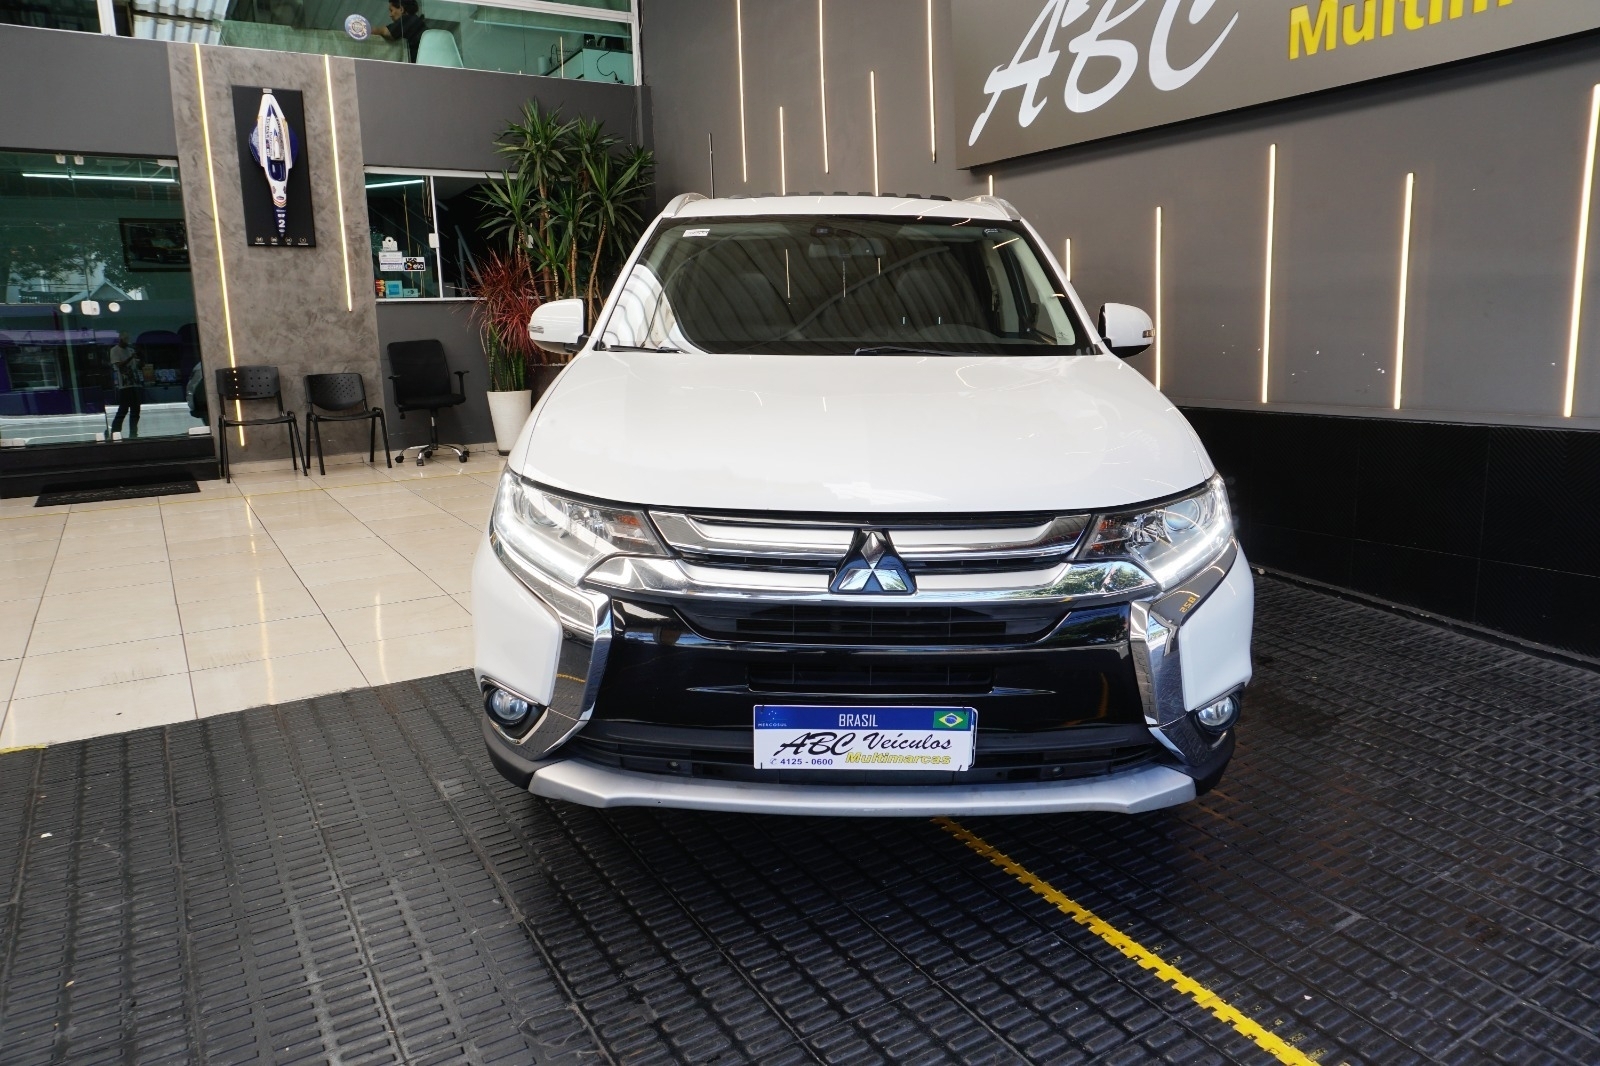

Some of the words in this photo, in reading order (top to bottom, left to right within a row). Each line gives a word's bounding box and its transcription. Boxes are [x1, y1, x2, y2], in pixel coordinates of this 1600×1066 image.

[968, 0, 1239, 147] ABC
[838, 713, 879, 727] BRASIL
[773, 731, 857, 757] ABC
[862, 731, 953, 751] Veículos
[779, 758, 803, 766] 4125
[811, 758, 834, 766] 0600
[844, 751, 952, 765] Multimarcas
